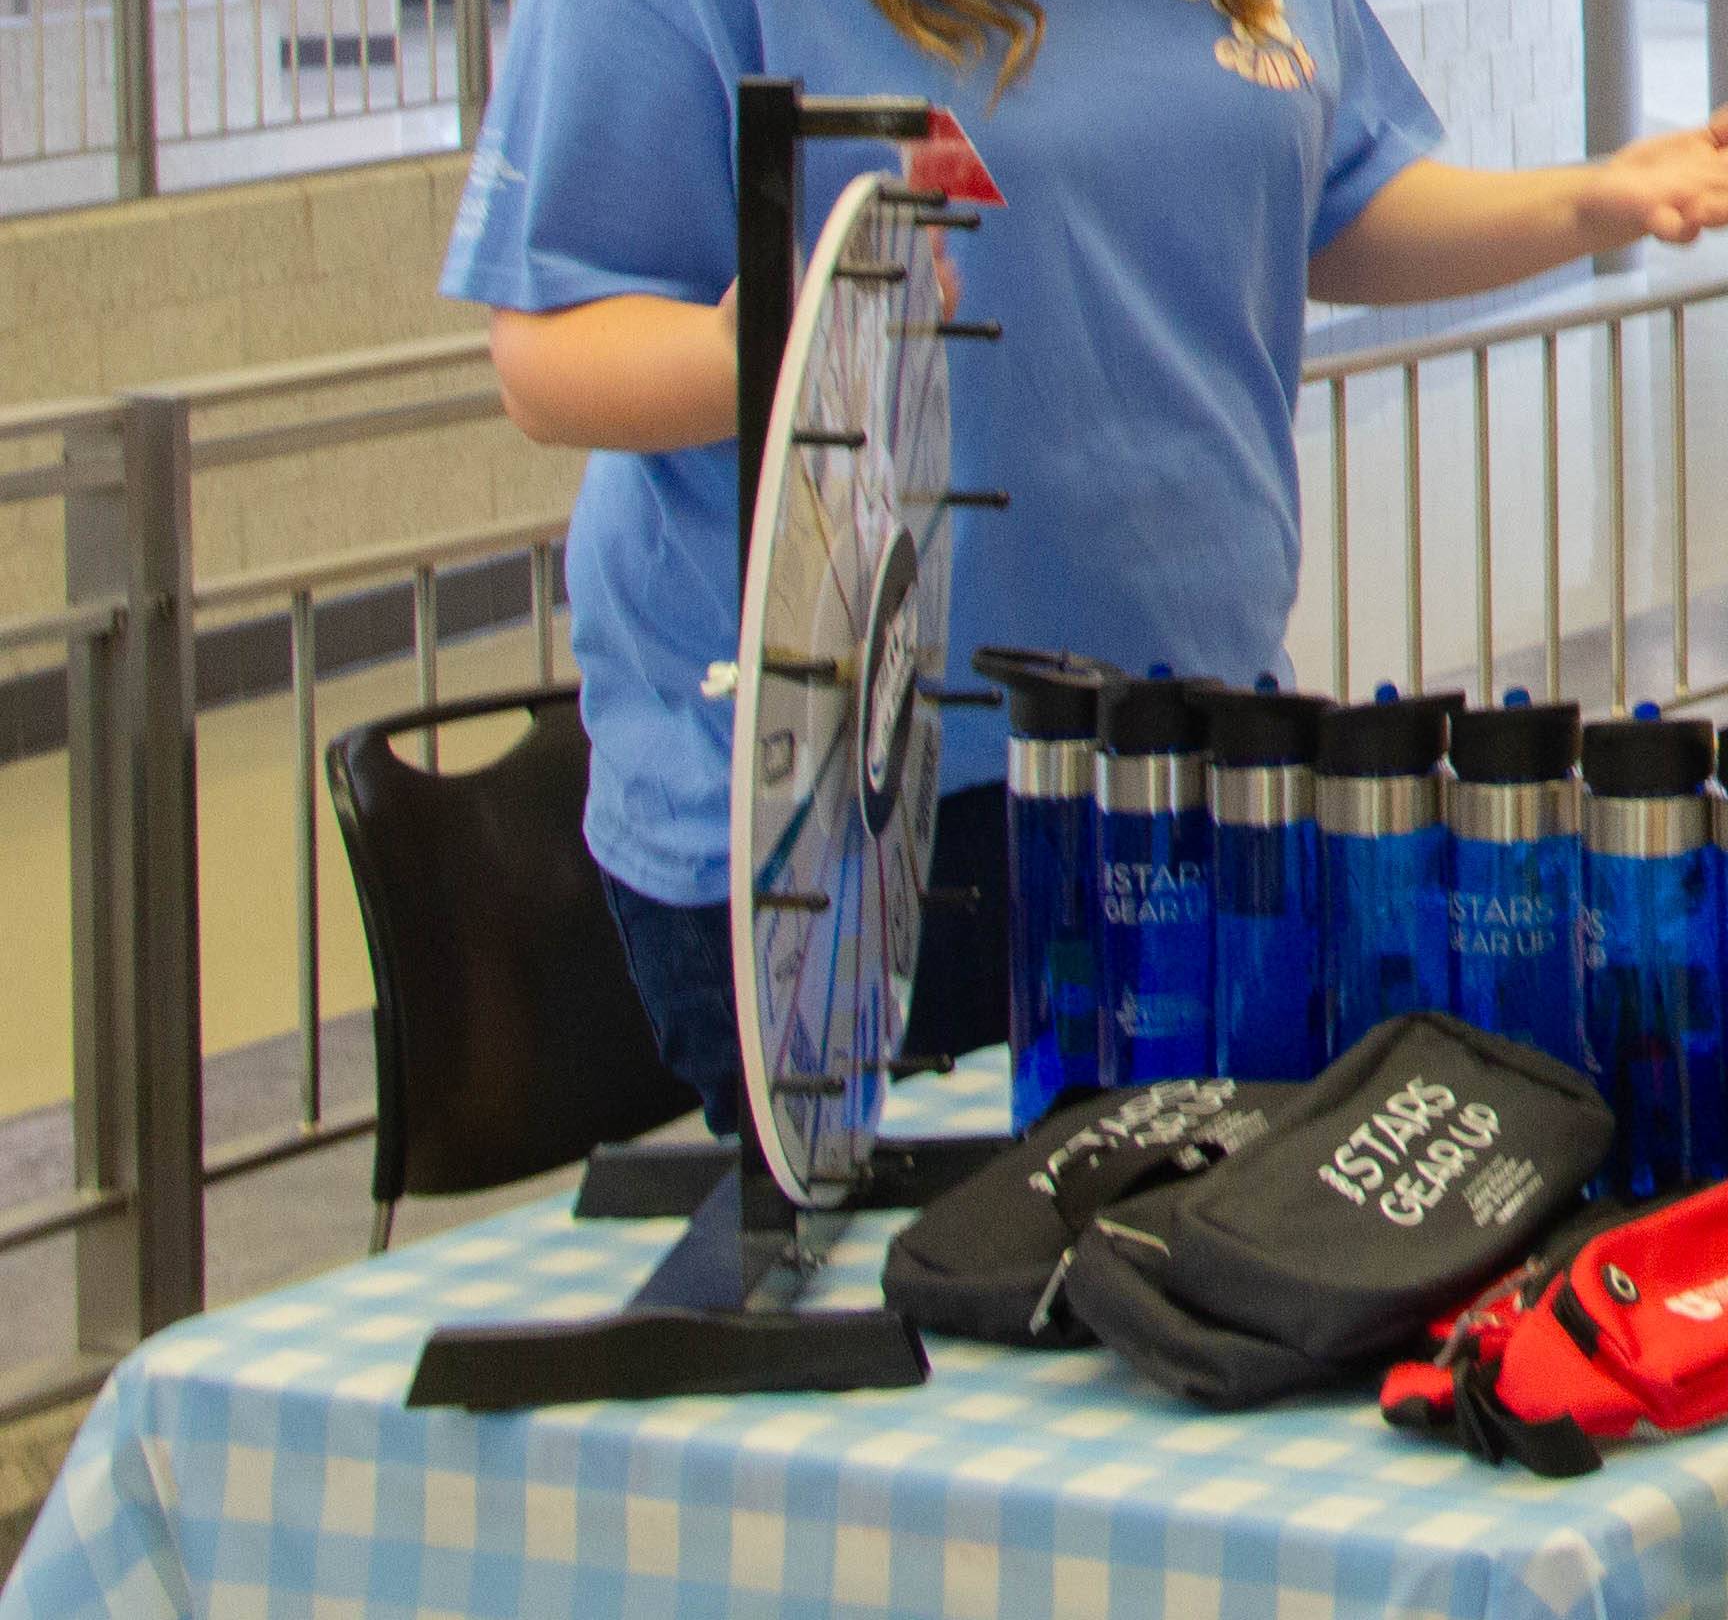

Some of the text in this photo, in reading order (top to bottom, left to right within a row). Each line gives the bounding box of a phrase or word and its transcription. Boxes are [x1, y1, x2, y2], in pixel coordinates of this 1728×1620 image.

[1450, 926, 1509, 957] EAR
[1379, 1101, 1502, 1227] GEAR UP
